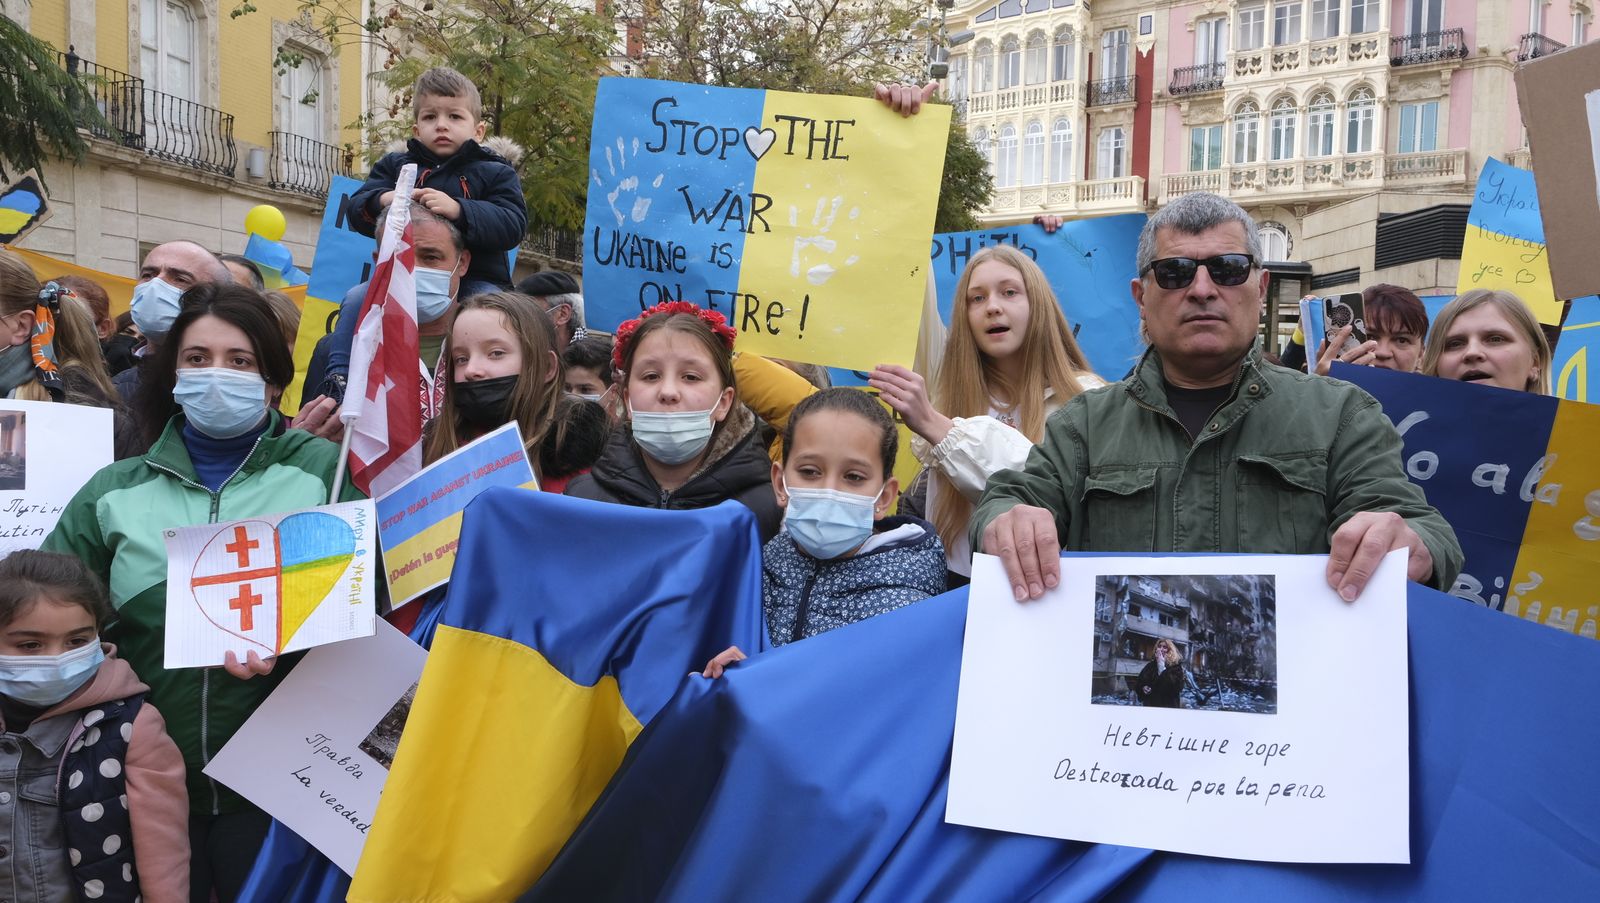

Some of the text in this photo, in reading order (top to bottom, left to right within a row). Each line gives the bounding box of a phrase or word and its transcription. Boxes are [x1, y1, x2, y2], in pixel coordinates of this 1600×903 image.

[775, 115, 856, 160] THE
[678, 185, 774, 234] WAR
[1471, 463, 1511, 495] a
[1519, 453, 1562, 507] la
[381, 511, 406, 533] STOP
[407, 497, 429, 515] WAR
[423, 552, 434, 564] la
[305, 733, 363, 780] Правда
[1103, 723, 1291, 766] Невтішне горе
[290, 765, 312, 788] La
[1235, 776, 1259, 796] la
[1265, 782, 1327, 806] pena
